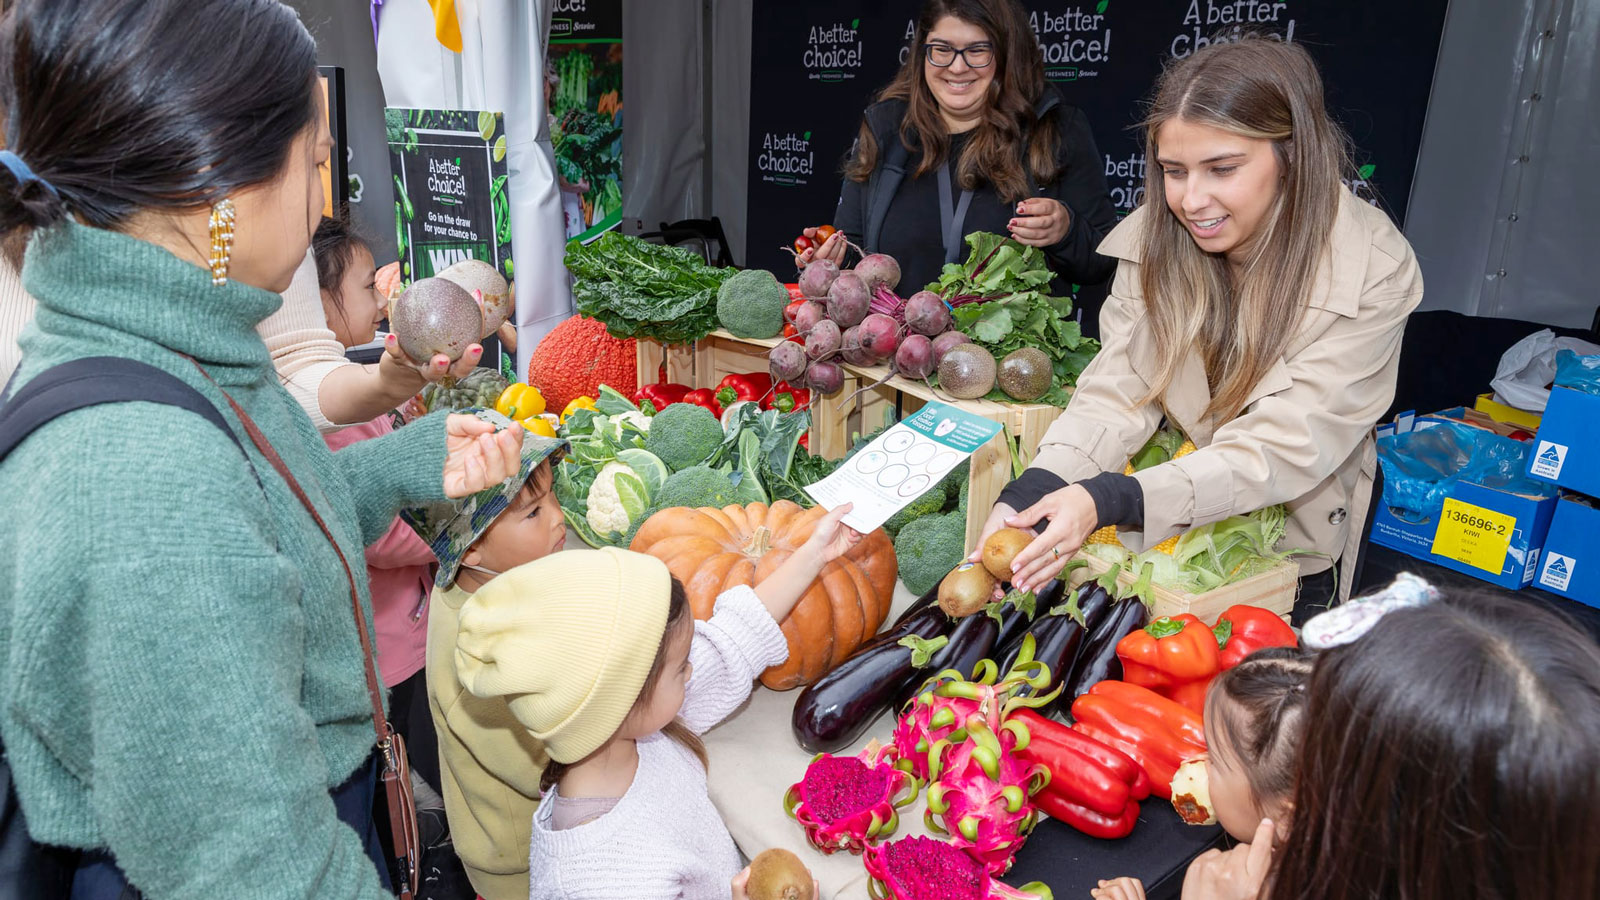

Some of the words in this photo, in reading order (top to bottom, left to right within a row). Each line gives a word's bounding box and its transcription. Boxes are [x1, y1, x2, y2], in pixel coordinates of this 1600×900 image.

[1043, 6, 1104, 34] better
[1205, 0, 1287, 24] better
[808, 25, 818, 44] A
[819, 22, 858, 44] better
[803, 41, 863, 68] choice!
[1034, 28, 1111, 63] hoice!
[762, 132, 773, 149] A
[773, 132, 810, 152] better
[428, 158, 437, 173] A
[435, 158, 461, 177] better
[758, 150, 814, 175] choice!
[1105, 153, 1146, 179] bett
[427, 173, 466, 196] choice!
[427, 211, 438, 222] Go
[438, 212, 445, 222] in
[444, 214, 456, 226] the
[455, 216, 472, 228] draw
[423, 222, 434, 233] for
[433, 224, 448, 236] your
[447, 226, 470, 240] chance
[469, 231, 478, 241] to
[1446, 509, 1507, 537] 136696-2
[1463, 528, 1481, 539] KIWI
